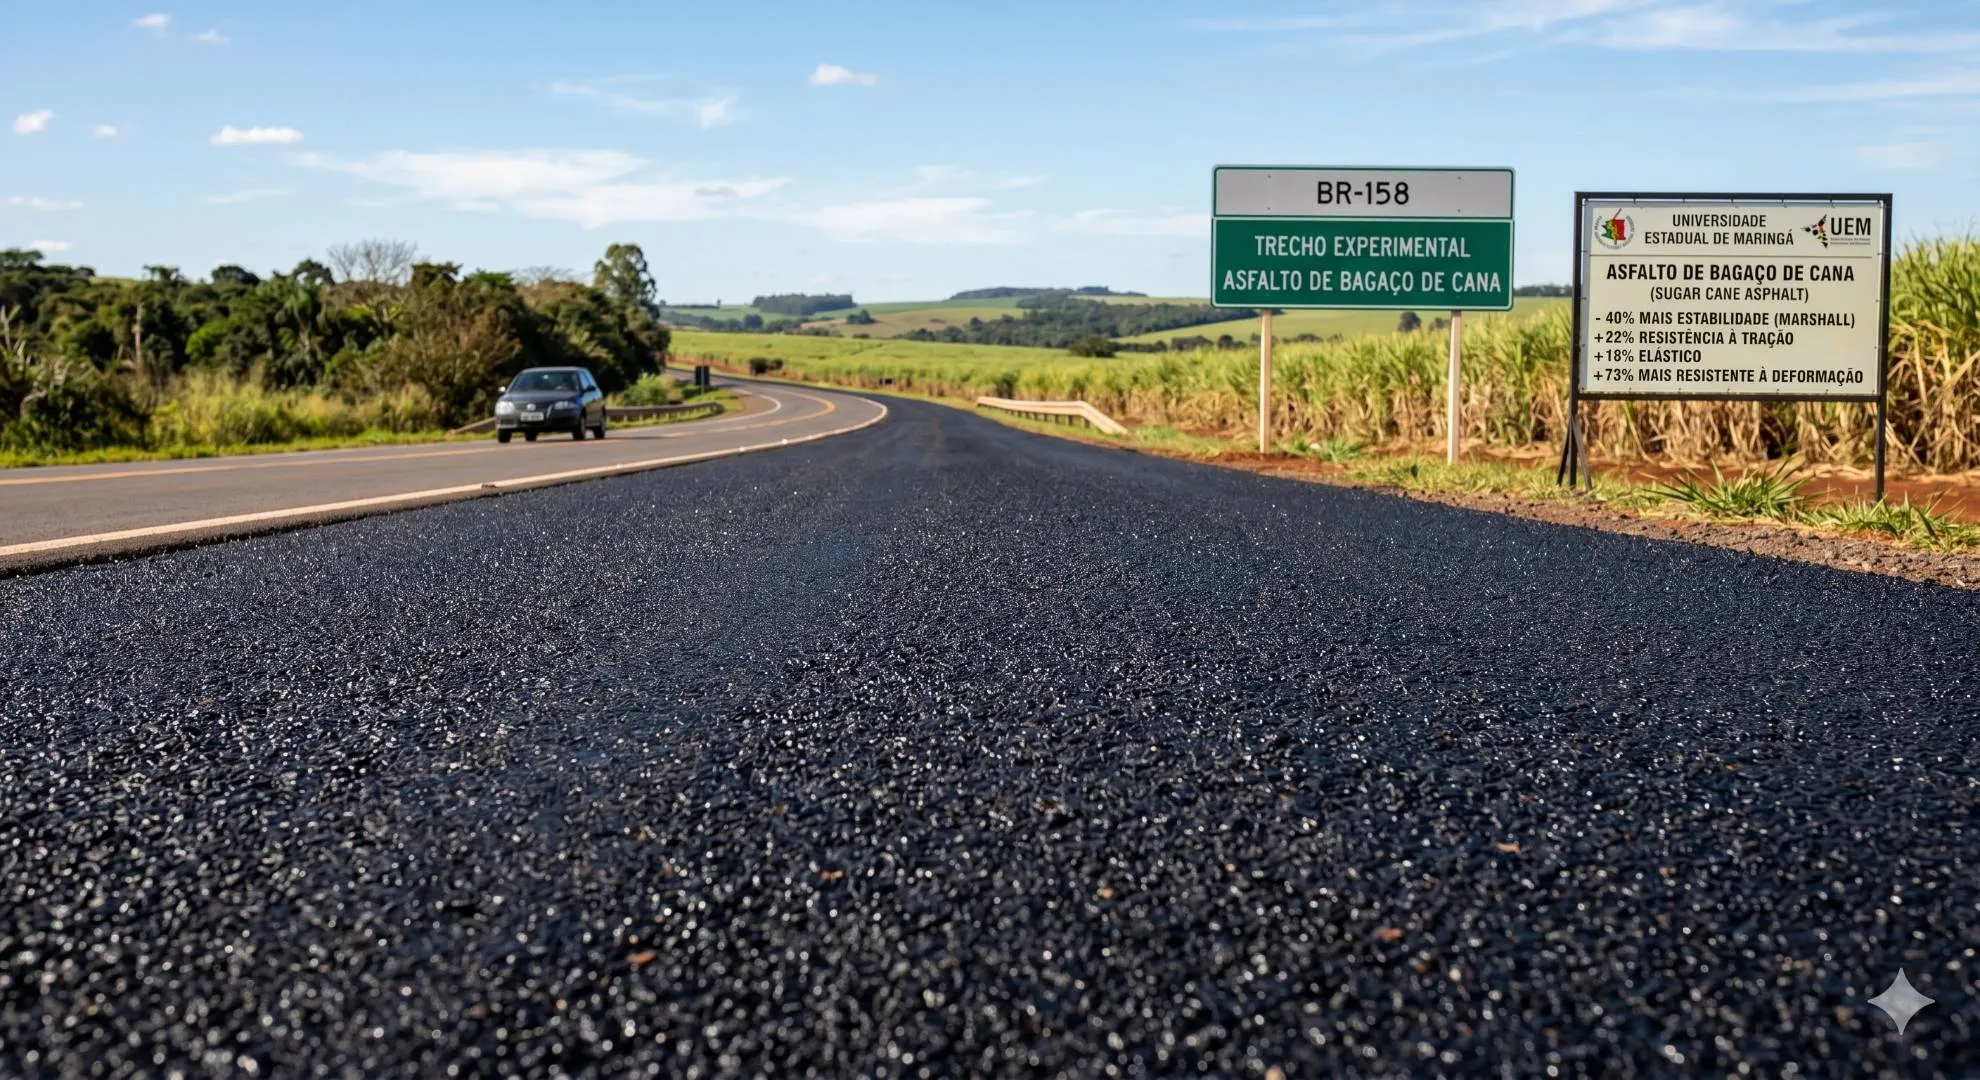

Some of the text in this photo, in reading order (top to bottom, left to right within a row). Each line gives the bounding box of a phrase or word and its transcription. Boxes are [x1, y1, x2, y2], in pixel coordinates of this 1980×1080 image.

[1318, 181, 1409, 205] BR-158
[1673, 215, 1766, 227] UNIVERSIDADE
[1831, 218, 1870, 235] UEM
[1645, 229, 1793, 245] ESTADUAL DE MARINGÁ
[1255, 236, 1470, 257] TRECHO EXPERIMENTAL
[1224, 270, 1500, 295] ASFALTO DE BAGAÇO DE CANA
[1607, 264, 1854, 285] ASFALTO DE BAGAÇO DE CANA
[1651, 287, 1808, 303] (SUGAR CANE ASPHALT)
[1640, 312, 1672, 324] MAIS
[1678, 312, 1768, 325] ESTABILIDADE
[1775, 313, 1854, 328] (MARSHALL)
[1640, 329, 1724, 344] RESISTÊNCIA
[1728, 329, 1737, 344] À
[1742, 329, 1793, 348] TRAÇÃO
[1640, 347, 1701, 362] ELÁSTICO
[1639, 369, 1671, 381] MAIS
[1677, 369, 1754, 382] RESISTENTE
[1758, 367, 1768, 382] À
[1773, 368, 1863, 386] DEFORMAÇÃO
